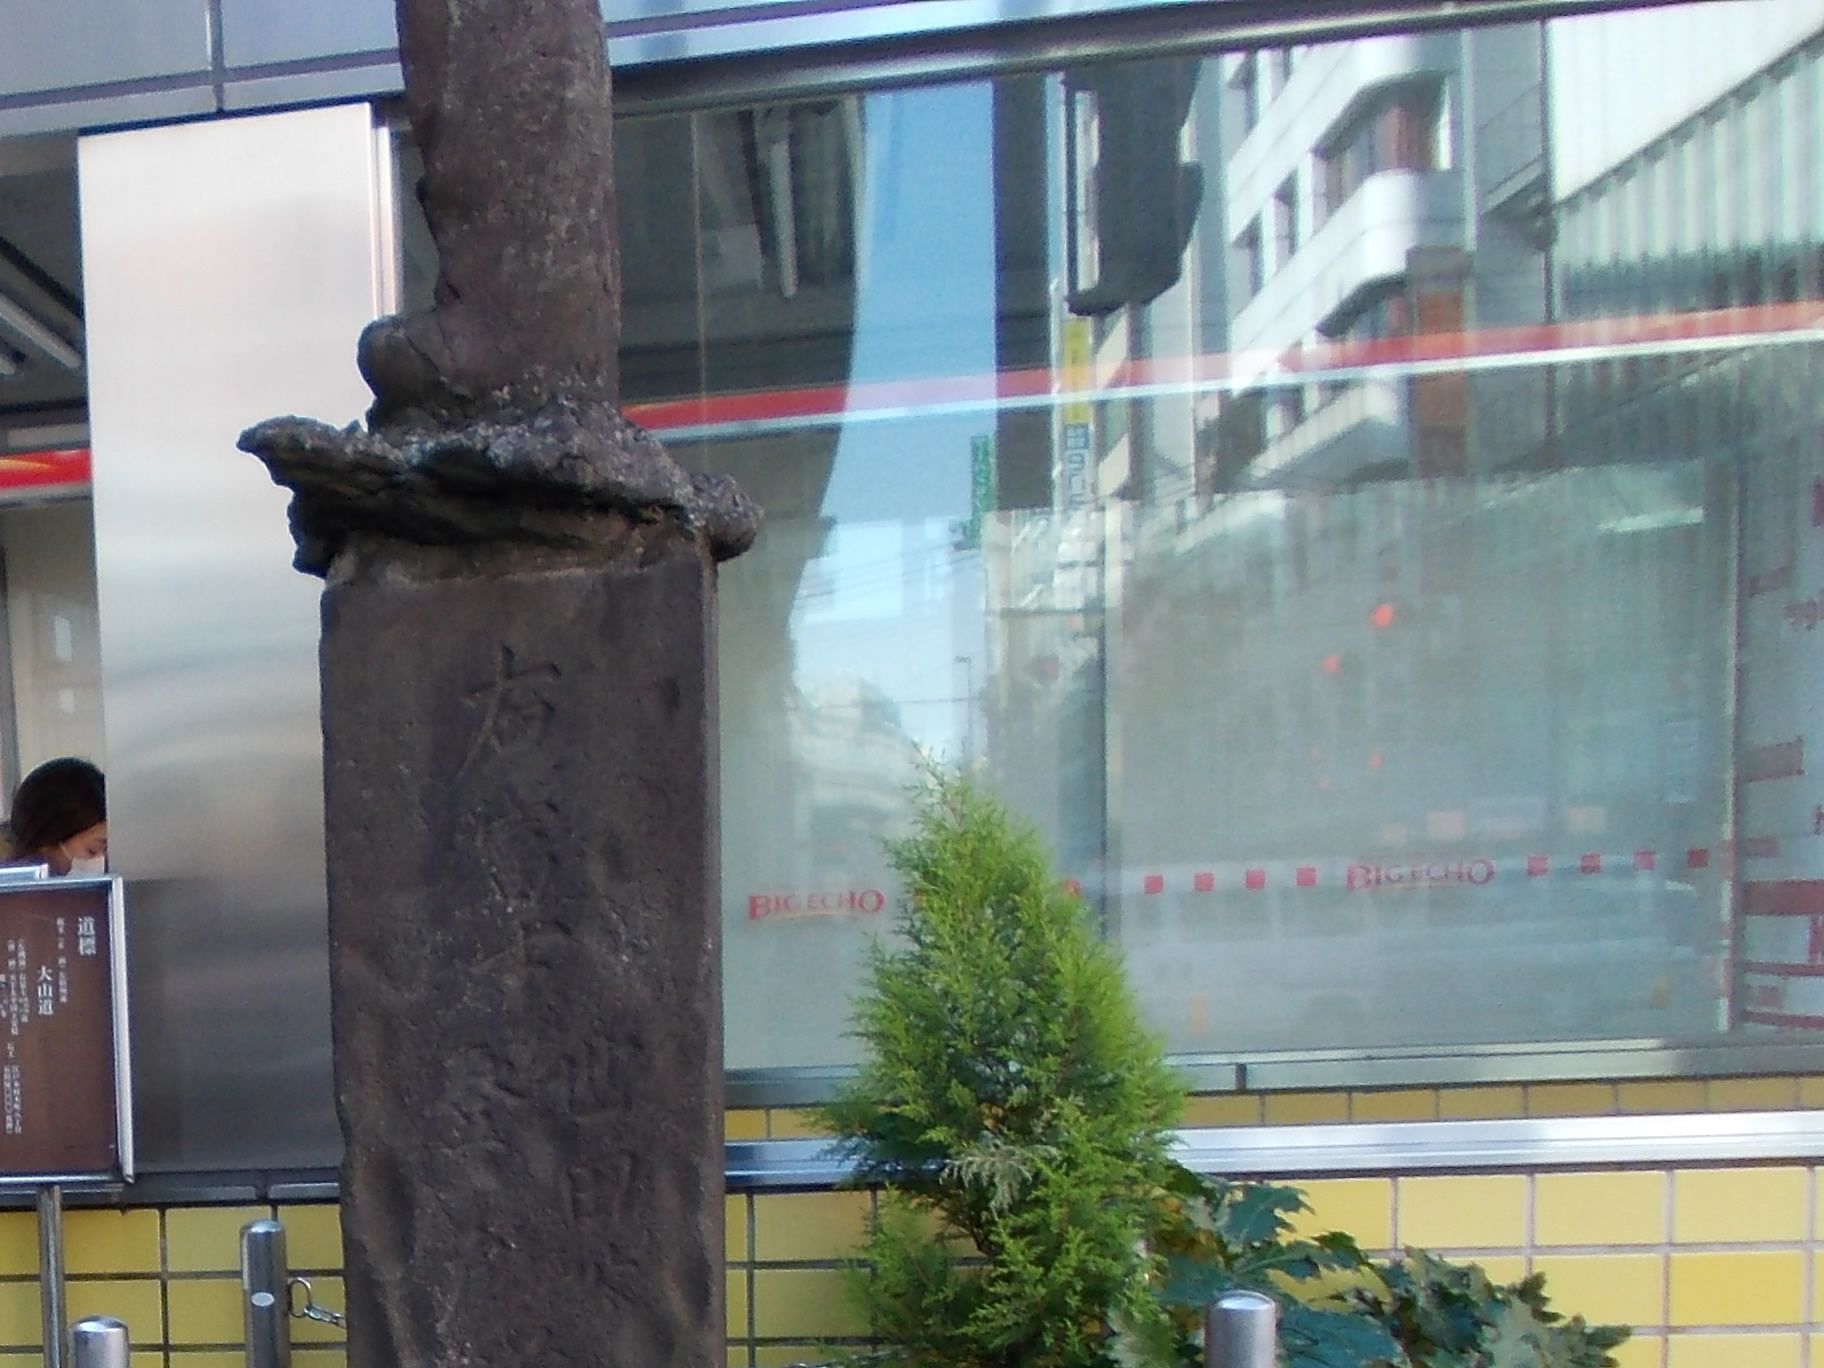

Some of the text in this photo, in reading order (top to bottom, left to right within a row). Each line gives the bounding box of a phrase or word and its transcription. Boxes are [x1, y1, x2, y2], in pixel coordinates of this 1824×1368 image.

[749, 890, 886, 920] BIG ECHO
[37, 964, 55, 1015] 大山道
